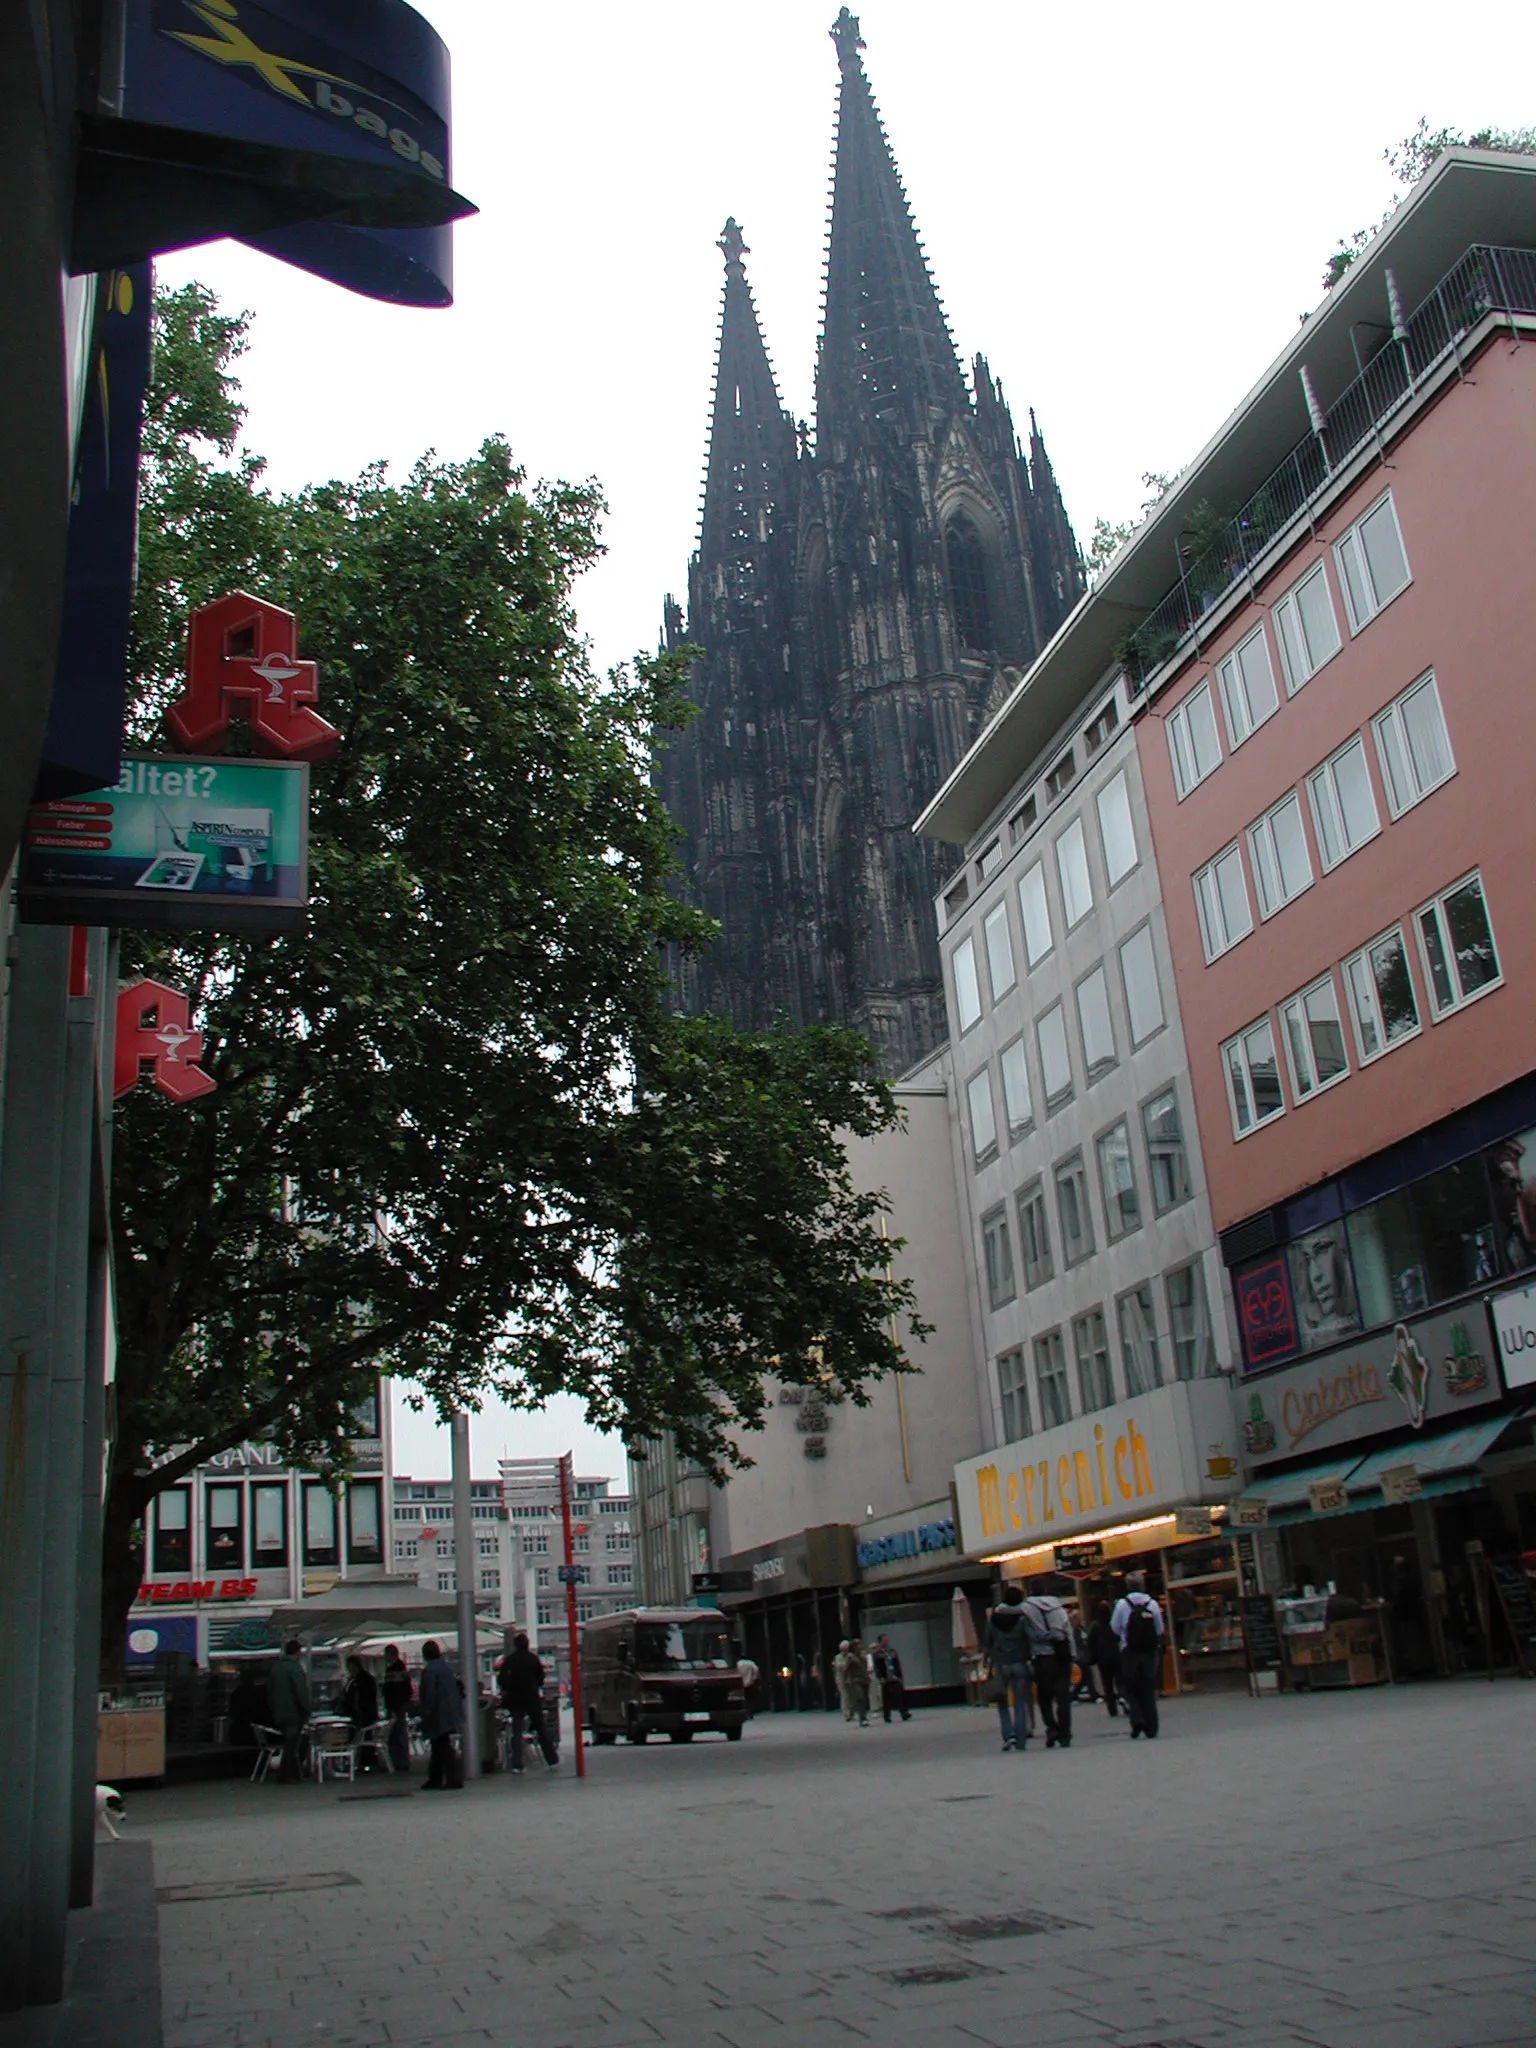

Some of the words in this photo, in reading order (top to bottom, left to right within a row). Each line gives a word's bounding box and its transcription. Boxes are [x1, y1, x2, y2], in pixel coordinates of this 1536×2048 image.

[313, 81, 446, 181] bags
[102, 761, 217, 799] ältet?
[191, 821, 235, 835] ASPIRIN
[219, 1577, 258, 1596] BS
